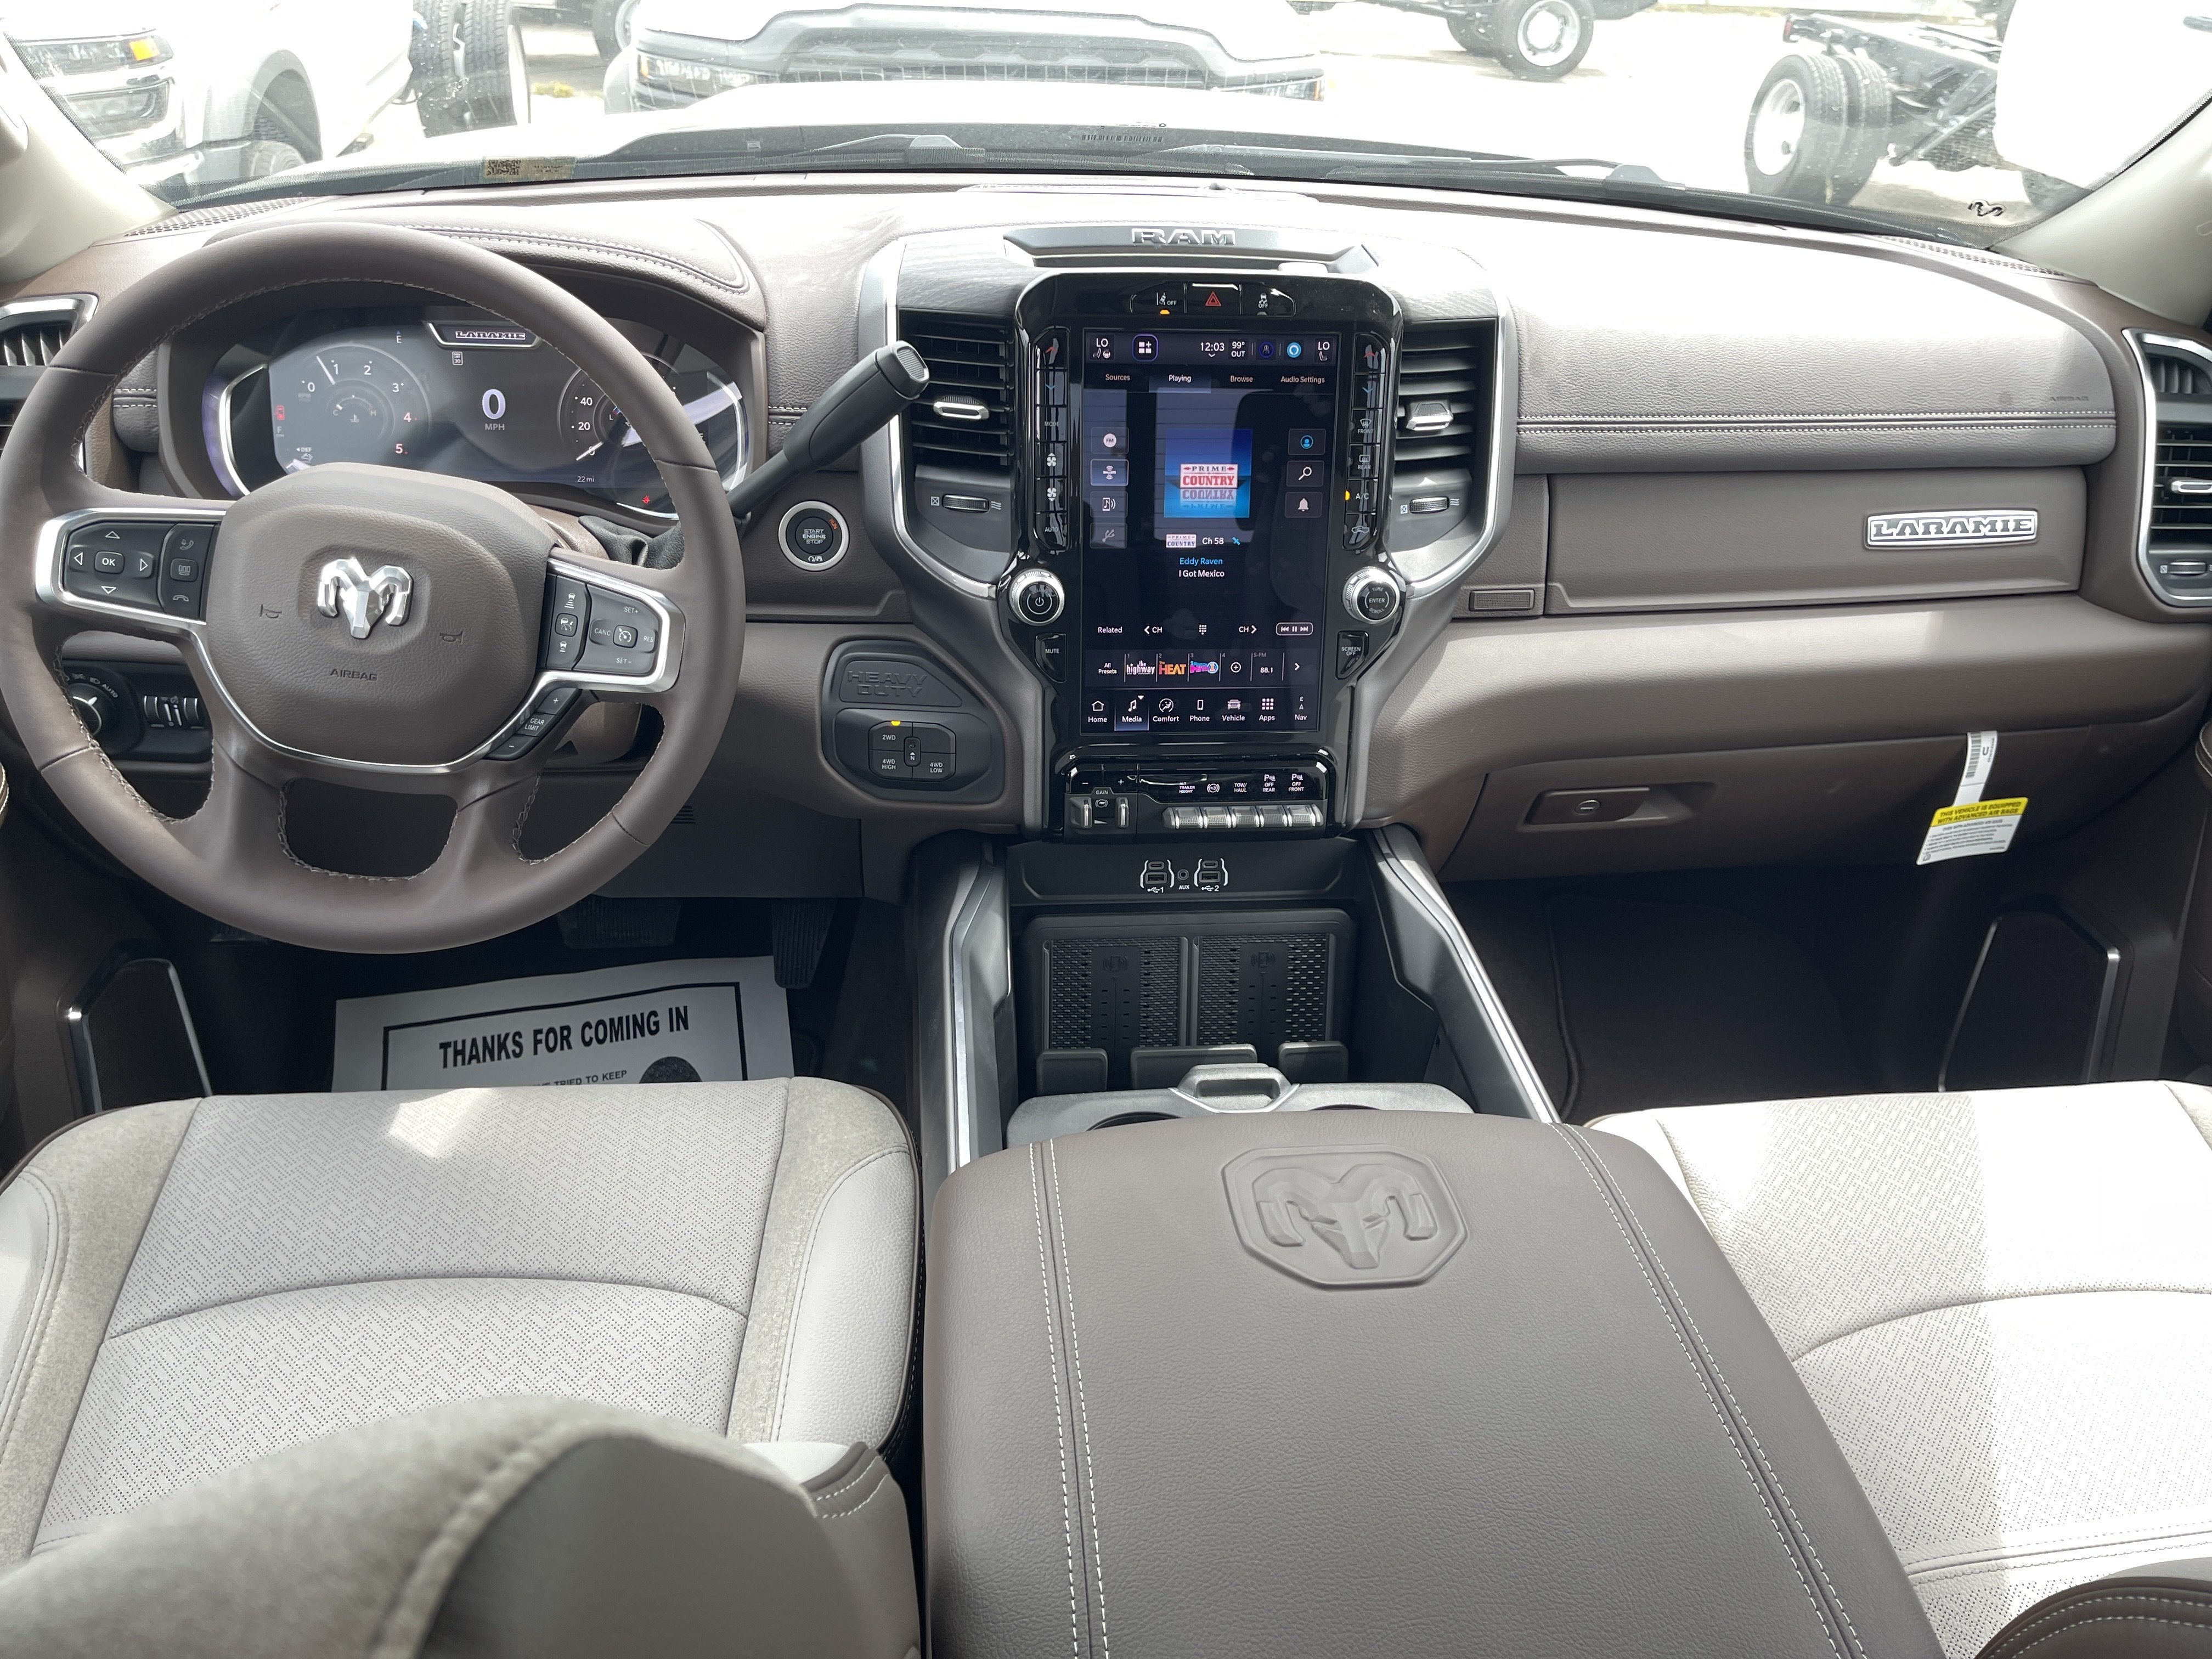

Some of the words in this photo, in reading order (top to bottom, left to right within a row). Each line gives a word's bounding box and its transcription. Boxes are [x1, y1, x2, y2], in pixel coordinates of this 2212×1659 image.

[1132, 228, 1235, 246] RAM
[396, 335, 402, 343] E
[455, 331, 526, 340] LARAMIE
[1096, 337, 1108, 347] LO
[1200, 342, 1225, 351] 12:03
[1318, 341, 1330, 351] LO
[333, 364, 338, 375] 1
[364, 365, 371, 375] 2
[1169, 374, 1192, 383] Playing
[308, 382, 315, 392] 0
[392, 382, 399, 393] 3
[482, 388, 506, 420] 0
[580, 397, 592, 405] 40
[403, 412, 411, 422] 4
[578, 422, 590, 431] 20
[395, 443, 403, 454] 5
[1183, 476, 1234, 486] COUNTRY
[1871, 516, 2034, 540] LARAMIE
[102, 557, 116, 567] OK
[1180, 557, 1199, 567] Eddy
[594, 628, 611, 636] CANC
[1126, 663, 1155, 675] highway
[1159, 664, 1186, 675] HEAT
[330, 668, 377, 681] AIRBAG
[848, 670, 927, 685] HEAVY
[857, 684, 922, 697] DUTY
[1955, 806, 1979, 816] VEHICLE
[439, 1031, 523, 1069] THANKS
[533, 1025, 573, 1056] FOR
[581, 1011, 660, 1047] COMING
[668, 1006, 689, 1032] IN
[585, 1075, 599, 1084] TO
[602, 1070, 627, 1081] KEEP
